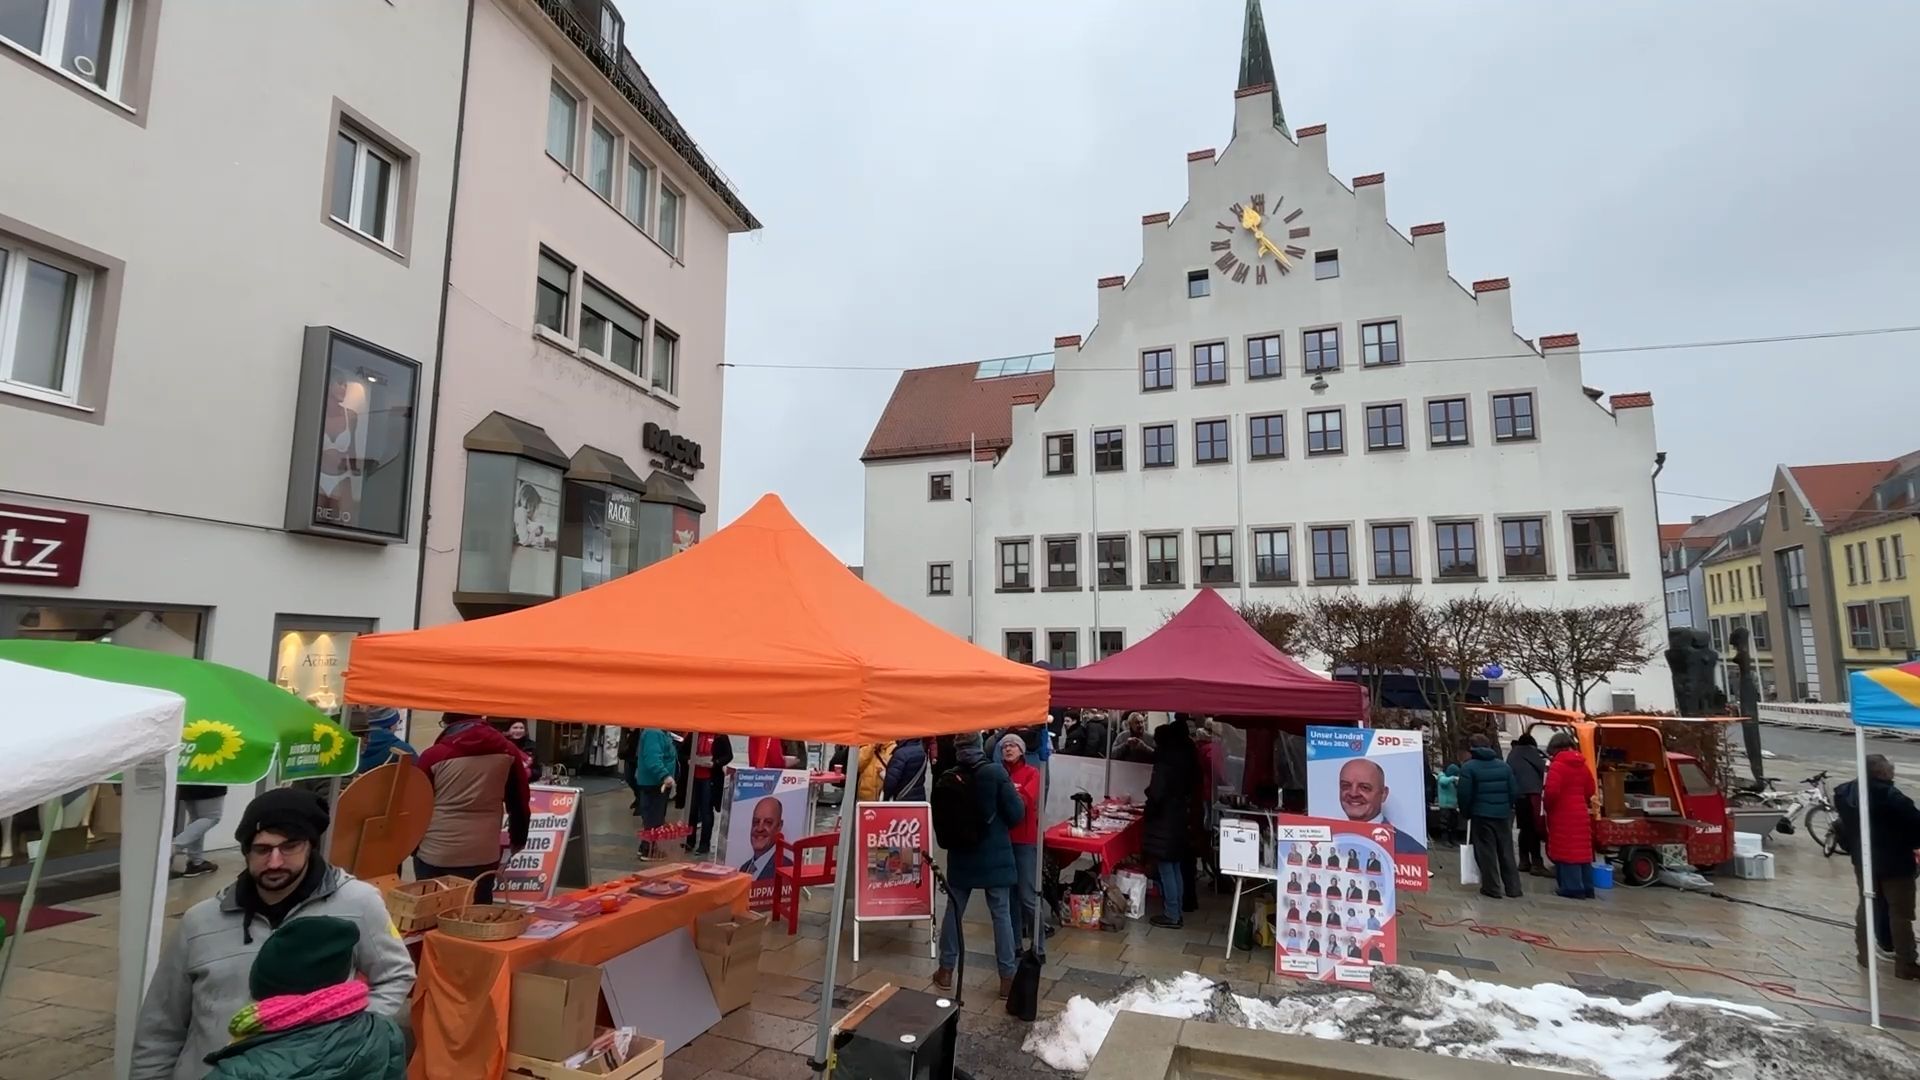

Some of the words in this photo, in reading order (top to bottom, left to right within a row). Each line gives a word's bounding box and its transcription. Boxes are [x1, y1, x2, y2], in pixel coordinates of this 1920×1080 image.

[643, 422, 704, 469] RACKL
[608, 501, 631, 524] RACKL
[1, 528, 62, 569] tz
[1310, 731, 1333, 739] Unser
[1334, 732, 1364, 740] Landrat
[1377, 736, 1400, 746] SPD
[782, 776, 796, 784] SPD
[887, 818, 920, 836] 100
[867, 830, 921, 848] BÄNKE
